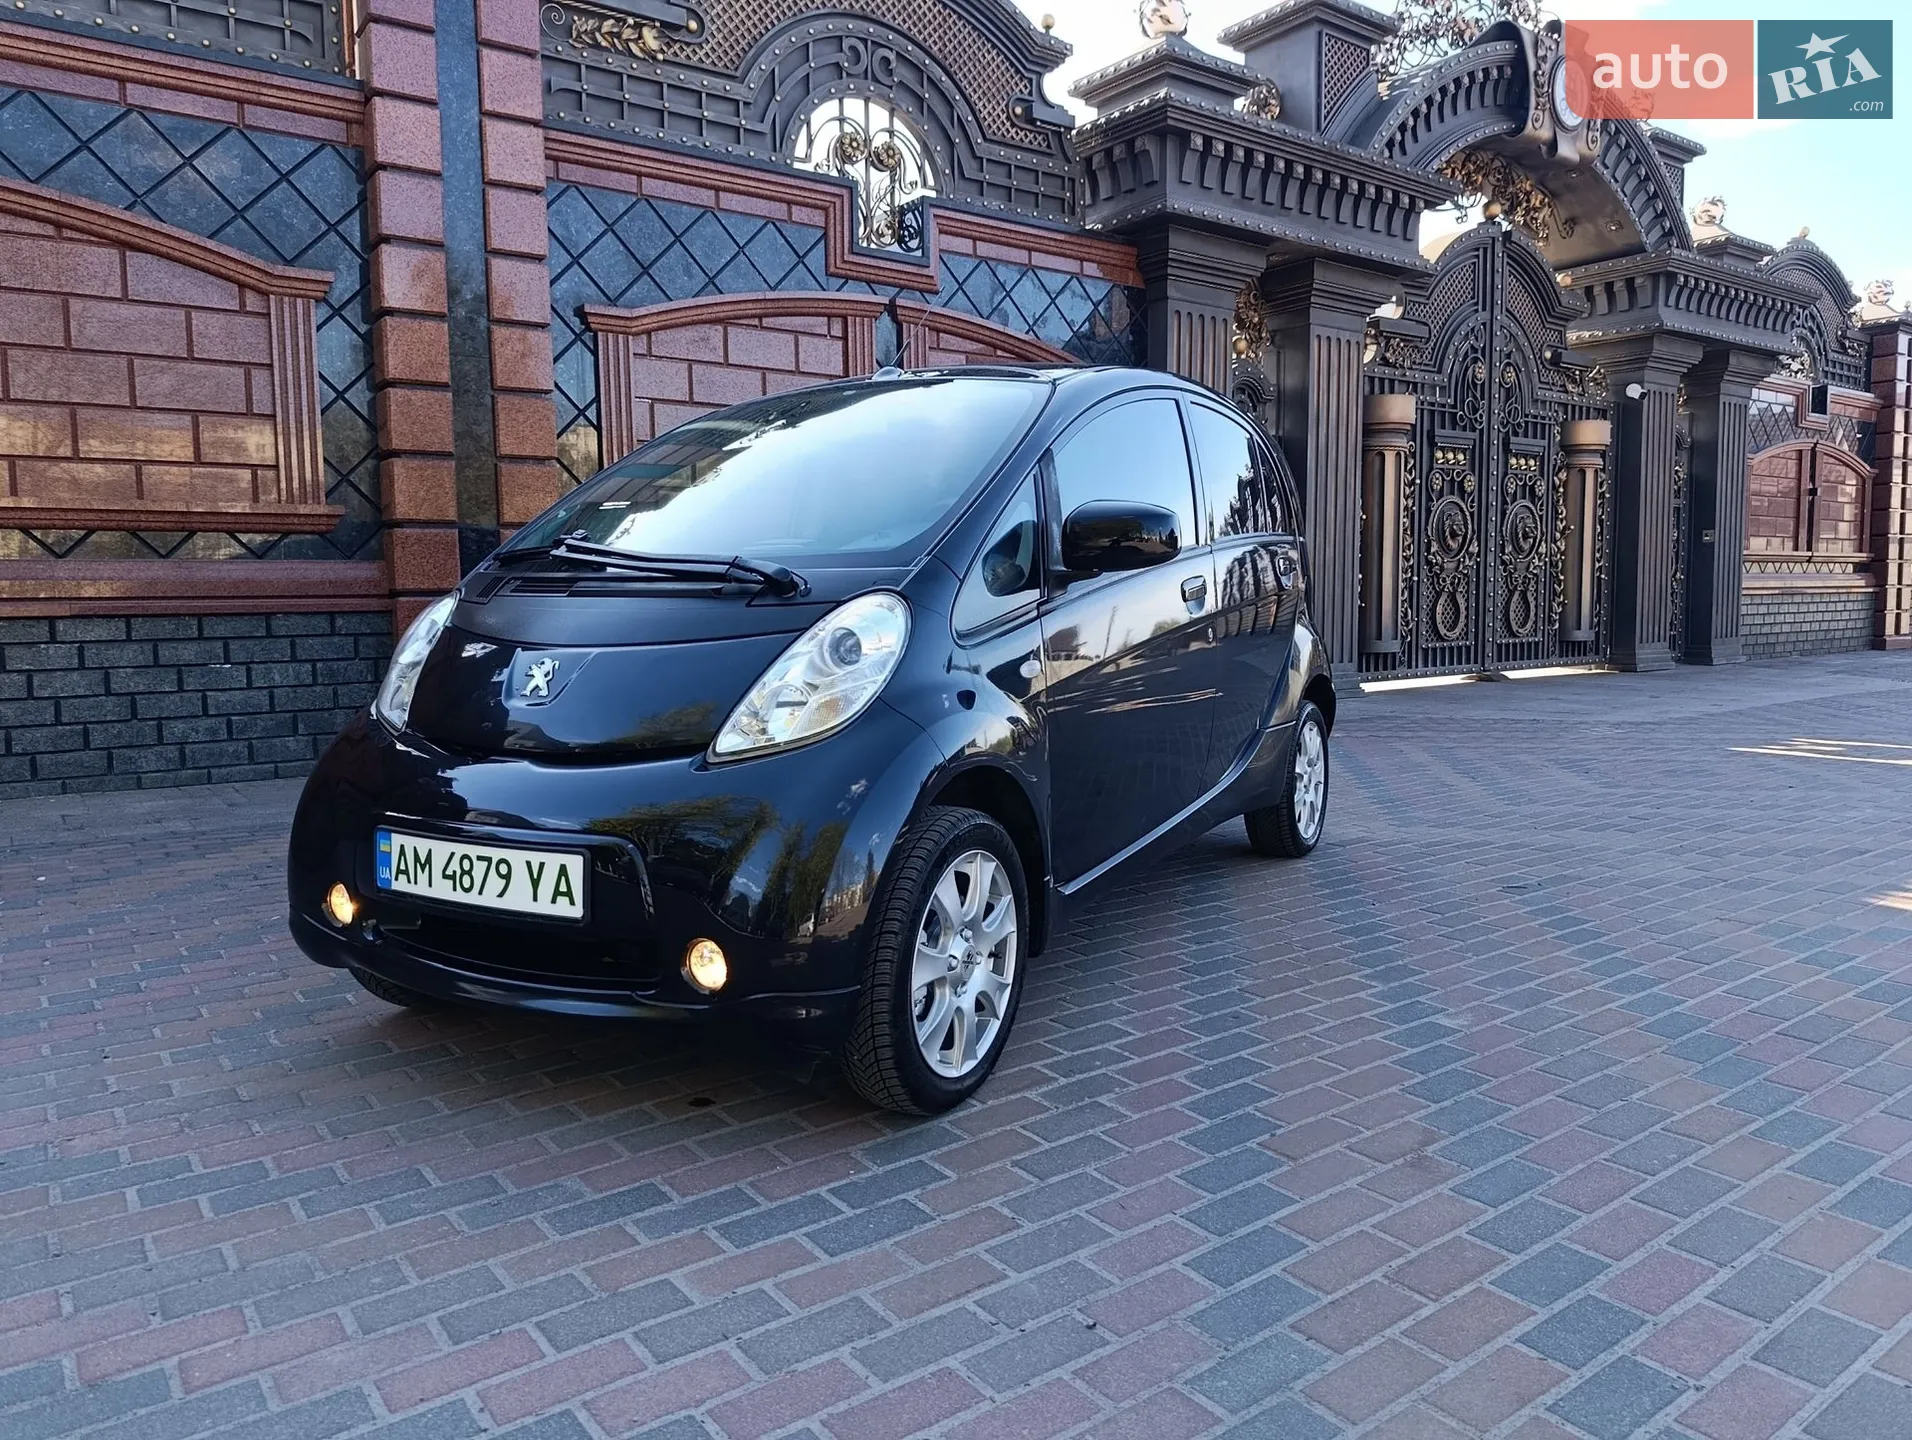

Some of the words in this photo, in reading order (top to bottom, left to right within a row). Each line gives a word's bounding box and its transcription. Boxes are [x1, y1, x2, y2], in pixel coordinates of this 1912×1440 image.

[379, 866, 391, 880] UA
[394, 844, 433, 888] AM
[442, 851, 513, 898] 4879
[525, 860, 576, 906] YA
